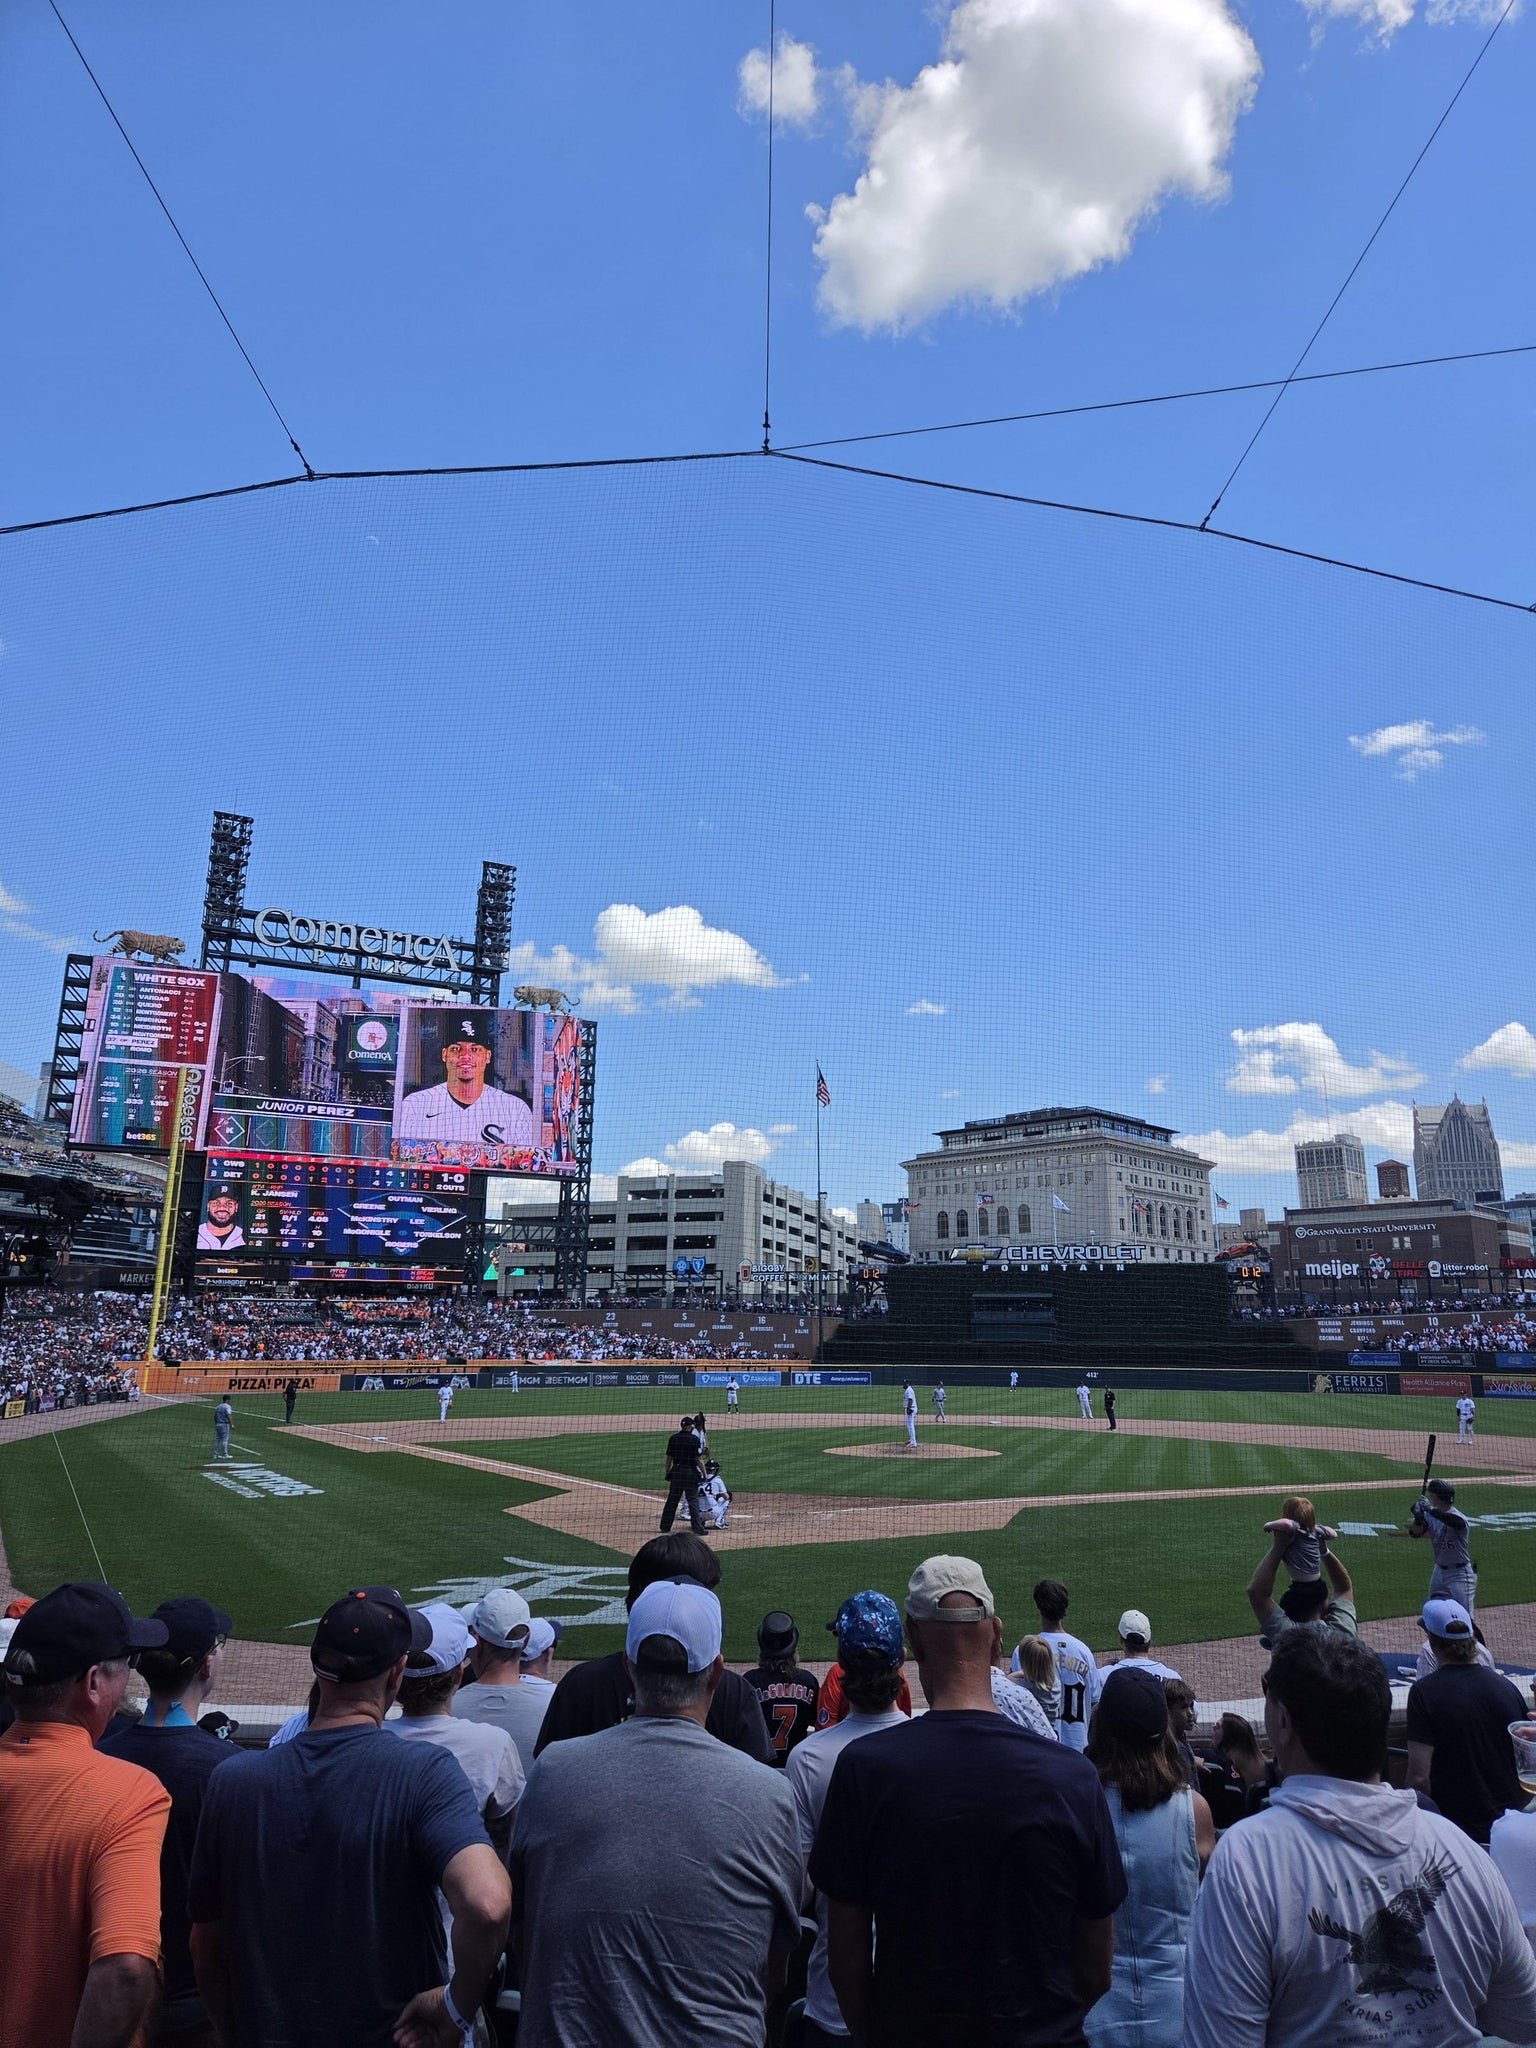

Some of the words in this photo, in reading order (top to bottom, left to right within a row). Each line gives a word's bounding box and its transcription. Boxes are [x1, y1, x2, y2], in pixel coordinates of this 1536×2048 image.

[312, 949, 408, 975] PARK
[134, 973, 176, 984] WHITE
[178, 977, 205, 987] SOX
[178, 1084, 200, 1142] Rocket
[256, 1101, 305, 1113] JUNIOR
[307, 1105, 355, 1117] PEREZ
[126, 1132, 156, 1140] bet365
[441, 1173, 465, 1183] 1-0
[421, 1206, 457, 1214] VIERLING
[351, 1216, 399, 1224] McKINSTRY
[343, 1228, 391, 1236] McGONIGLE
[1307, 1228, 1334, 1236] GRAND
[1334, 1227, 1362, 1235] VALLEY
[1362, 1225, 1386, 1233] STATE
[1386, 1223, 1437, 1232] UNIVERSITY
[414, 1231, 461, 1239] TORKELSON
[1007, 1245, 1146, 1261] CHEVROLET
[752, 1264, 785, 1272] BIGGBY
[982, 1264, 1125, 1272] FOUNTAIN
[1305, 1260, 1359, 1279] meijer
[752, 1274, 785, 1282] COFFEE
[758, 1316, 766, 1325] 16
[1427, 1317, 1438, 1326] 10
[1471, 1314, 1480, 1322] 11
[1514, 1313, 1526, 1322] 42
[698, 1330, 708, 1338] 47
[739, 1332, 744, 1340] 3
[552, 1377, 589, 1385] BETMGM
[795, 1374, 821, 1384] DTE
[1335, 1376, 1384, 1387] FERRIS
[228, 1378, 270, 1390] PIZZA!
[273, 1378, 315, 1390] PIZZA!
[1490, 1380, 1533, 1393] Surfside
[771, 1704, 797, 1750] 7
